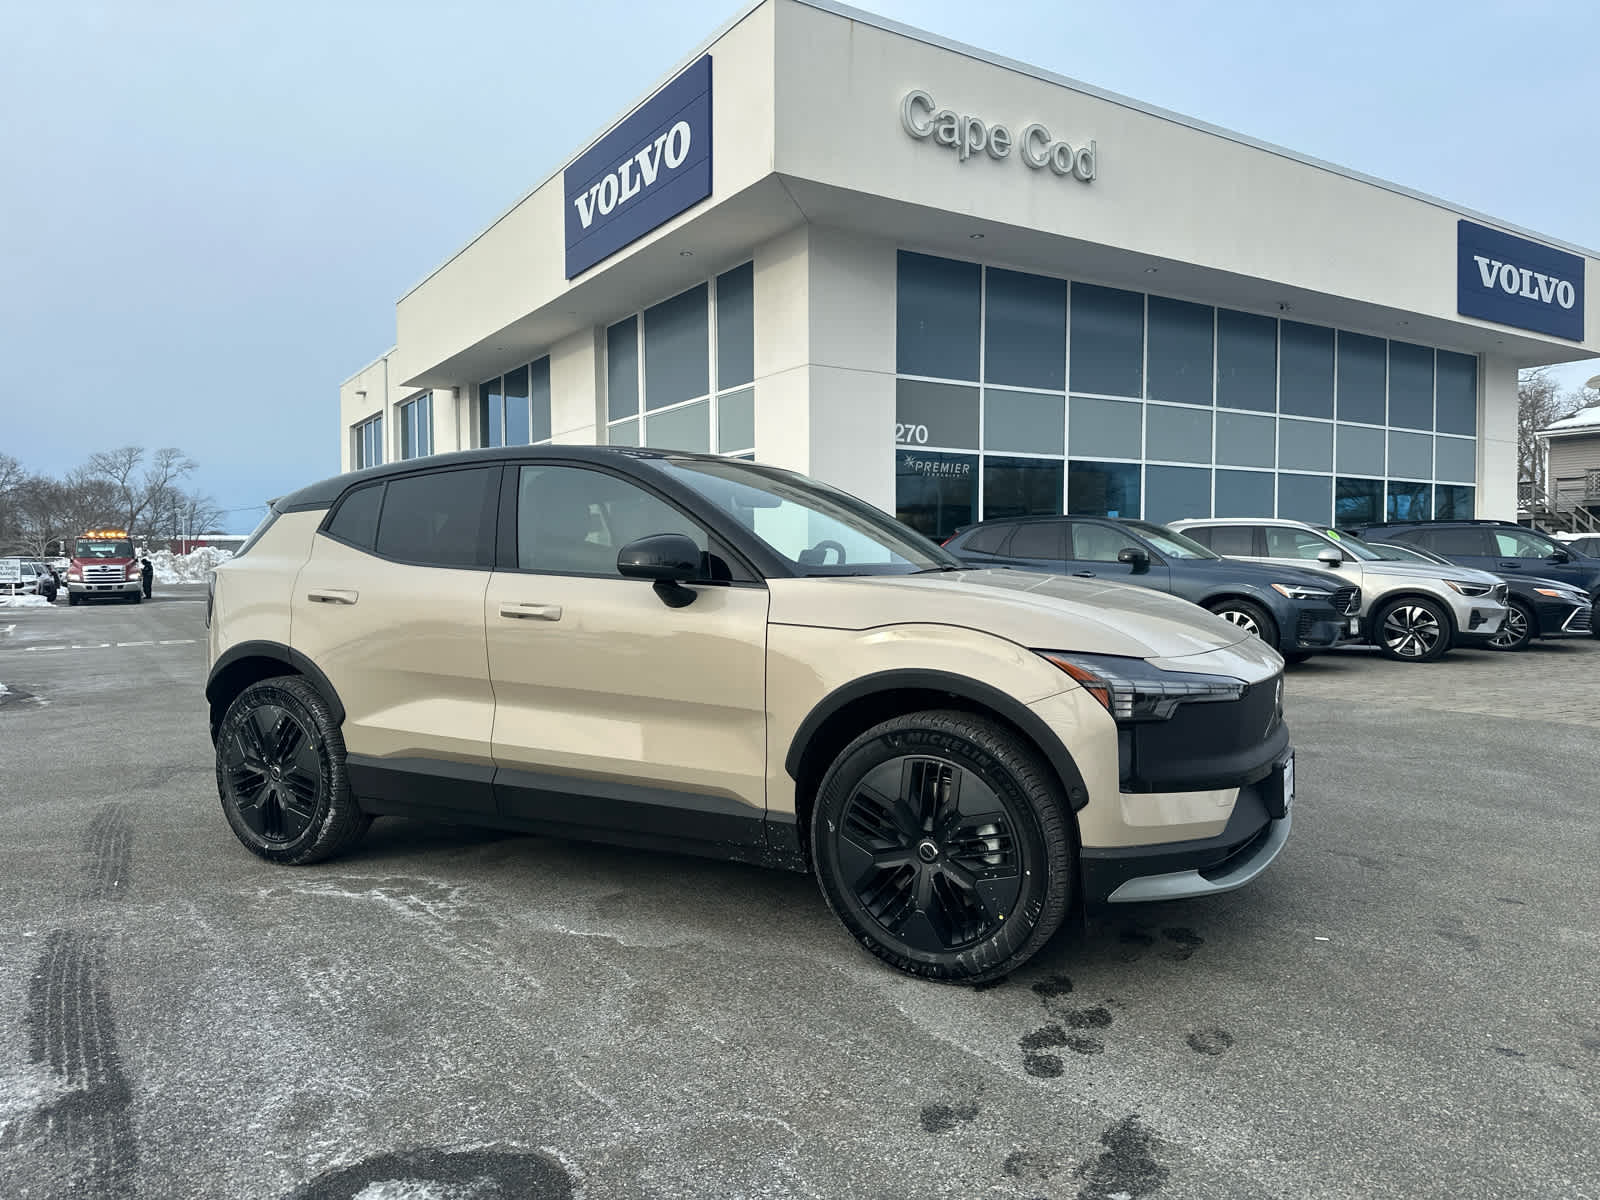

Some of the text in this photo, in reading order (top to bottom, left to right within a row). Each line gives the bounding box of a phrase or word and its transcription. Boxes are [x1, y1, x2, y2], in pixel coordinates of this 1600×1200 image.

[901, 89, 1097, 183] Cape Cod
[574, 120, 692, 229] VOLVO
[1473, 255, 1576, 309] VOLVO
[896, 423, 929, 444] 270
[915, 461, 970, 475] PREMIER
[906, 732, 992, 767] MICHELIN
